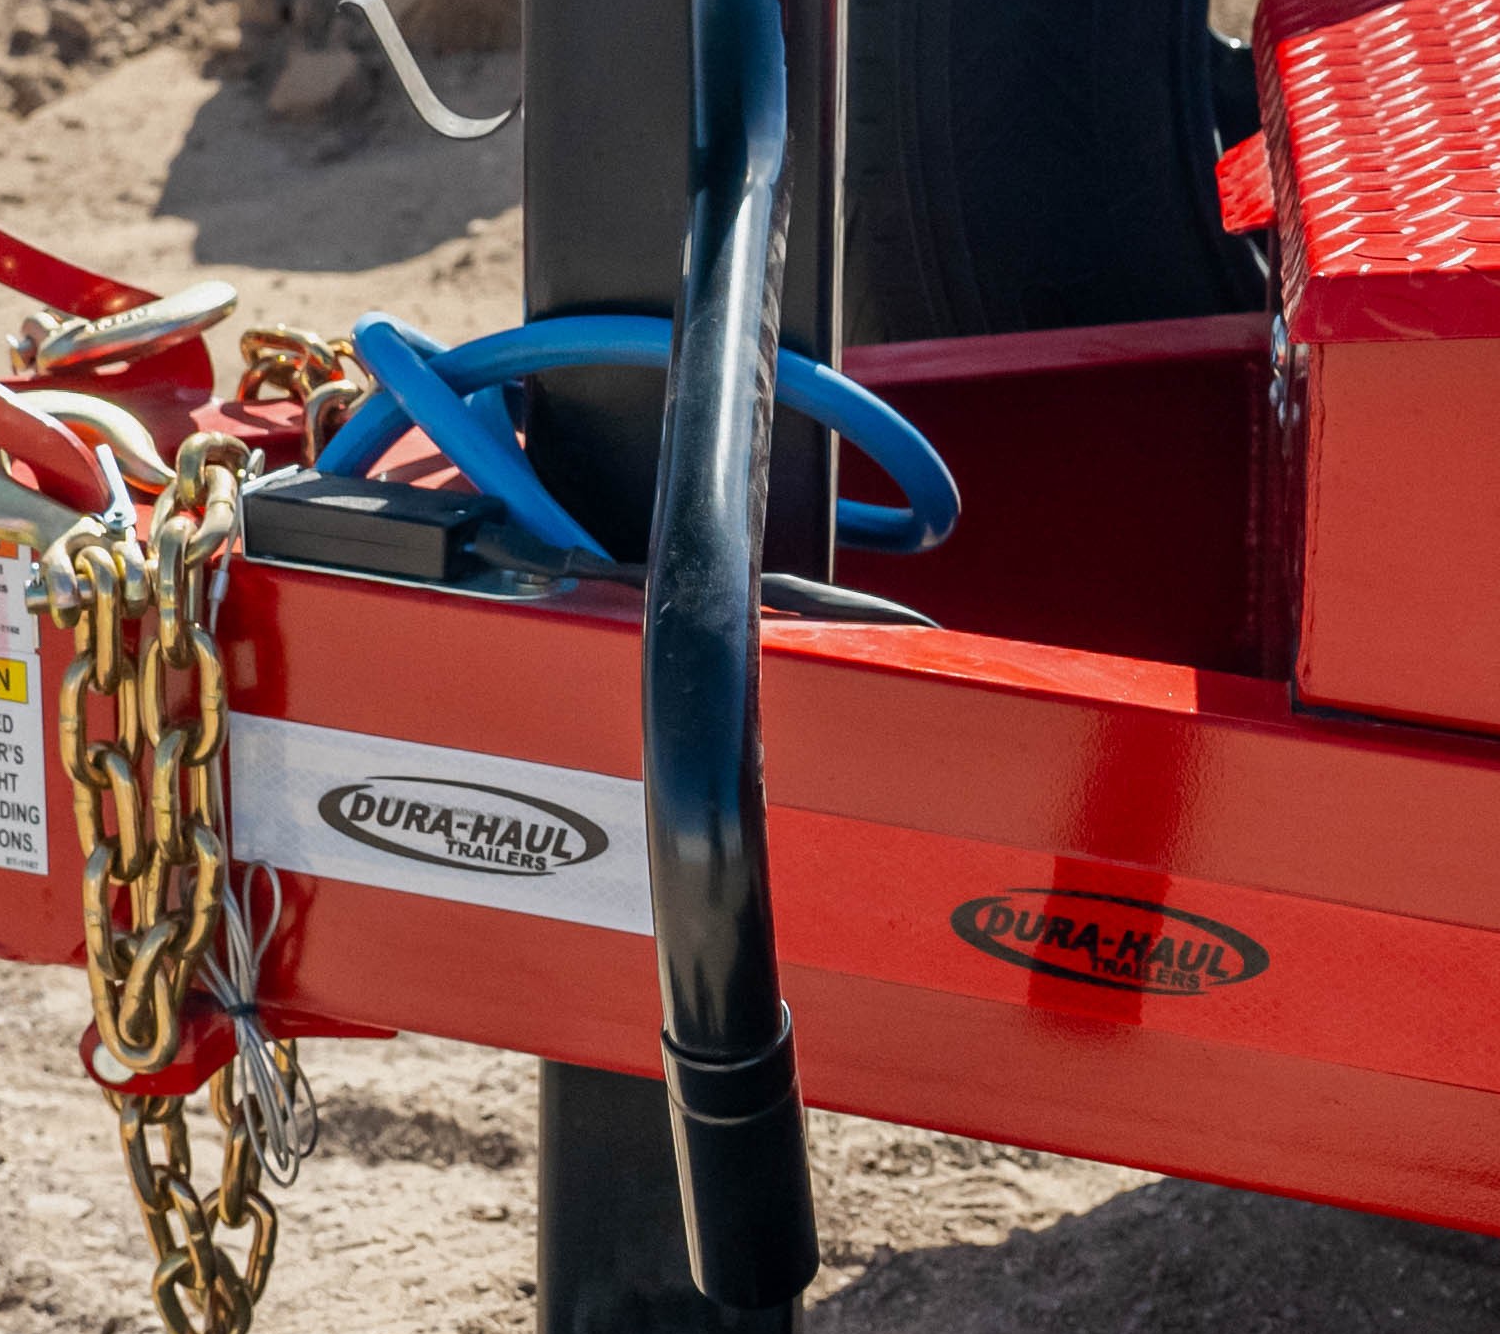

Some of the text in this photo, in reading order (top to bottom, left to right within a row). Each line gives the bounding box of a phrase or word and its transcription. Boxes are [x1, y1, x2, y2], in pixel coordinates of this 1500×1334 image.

[350, 792, 573, 860] DURA-HAUL
[445, 839, 547, 871] TRAILERS
[984, 903, 1230, 979] DURA-HAUL
[1091, 958, 1200, 990] TRAILERS
